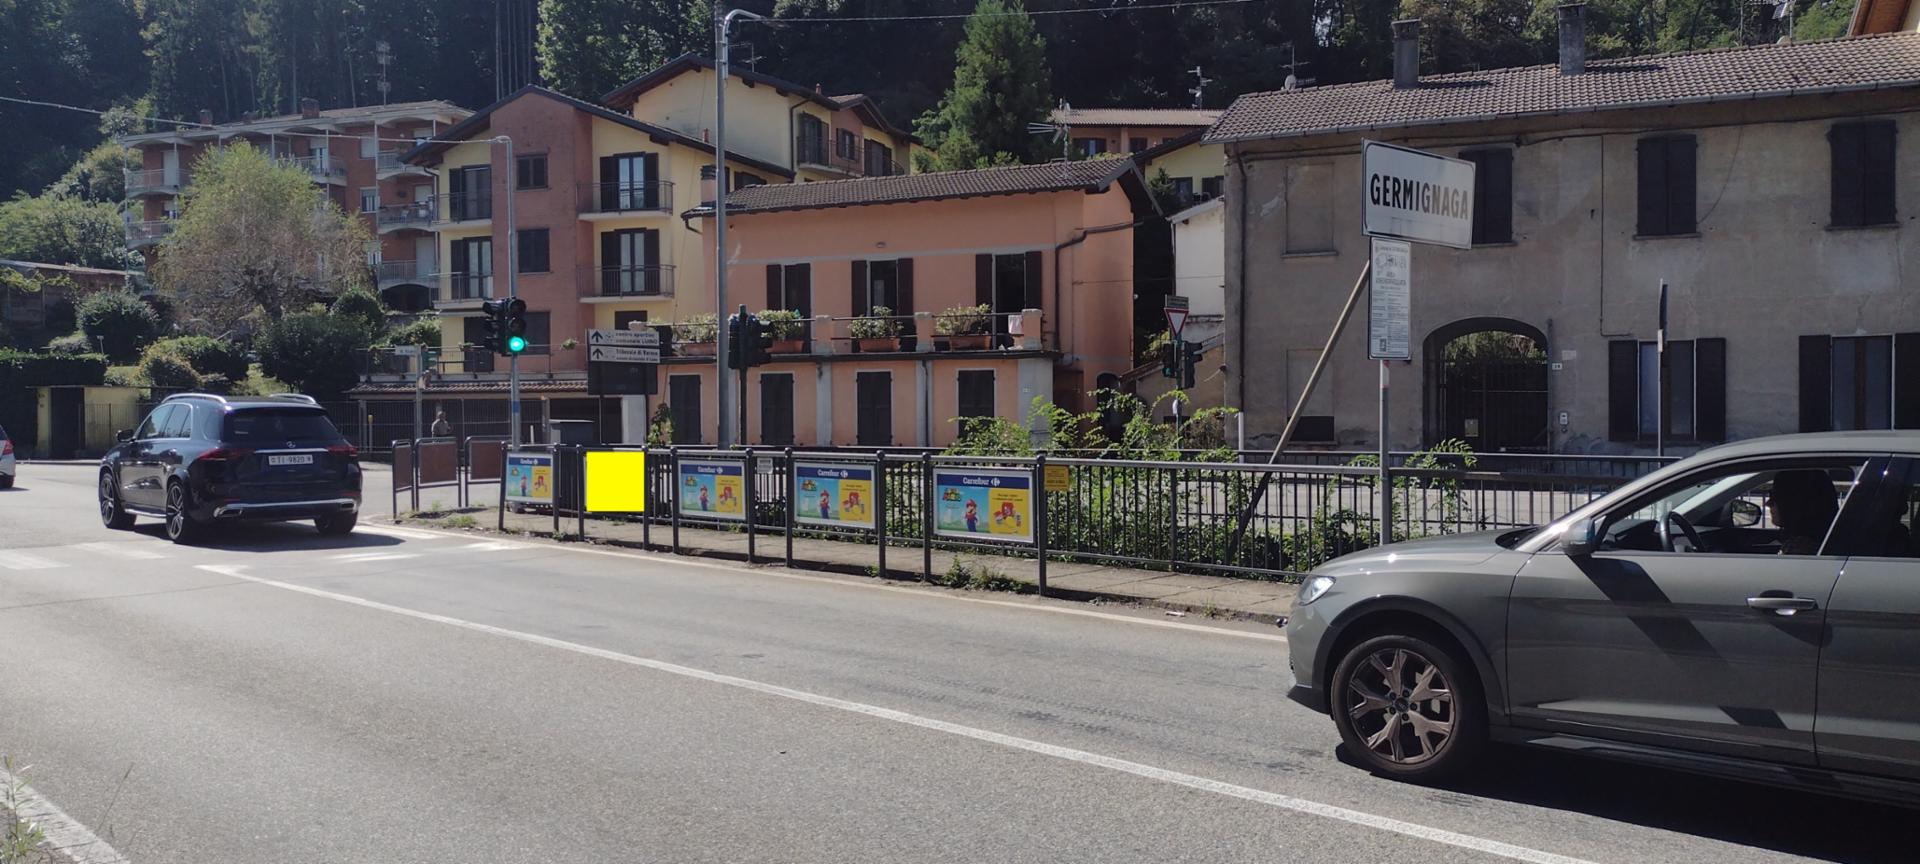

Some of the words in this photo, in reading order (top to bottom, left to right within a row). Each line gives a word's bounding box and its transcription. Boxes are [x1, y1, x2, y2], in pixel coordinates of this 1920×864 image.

[1370, 173, 1468, 220] GERMIGNAGA
[817, 469, 839, 477] Carrefour
[962, 477, 989, 485] Carrefour
